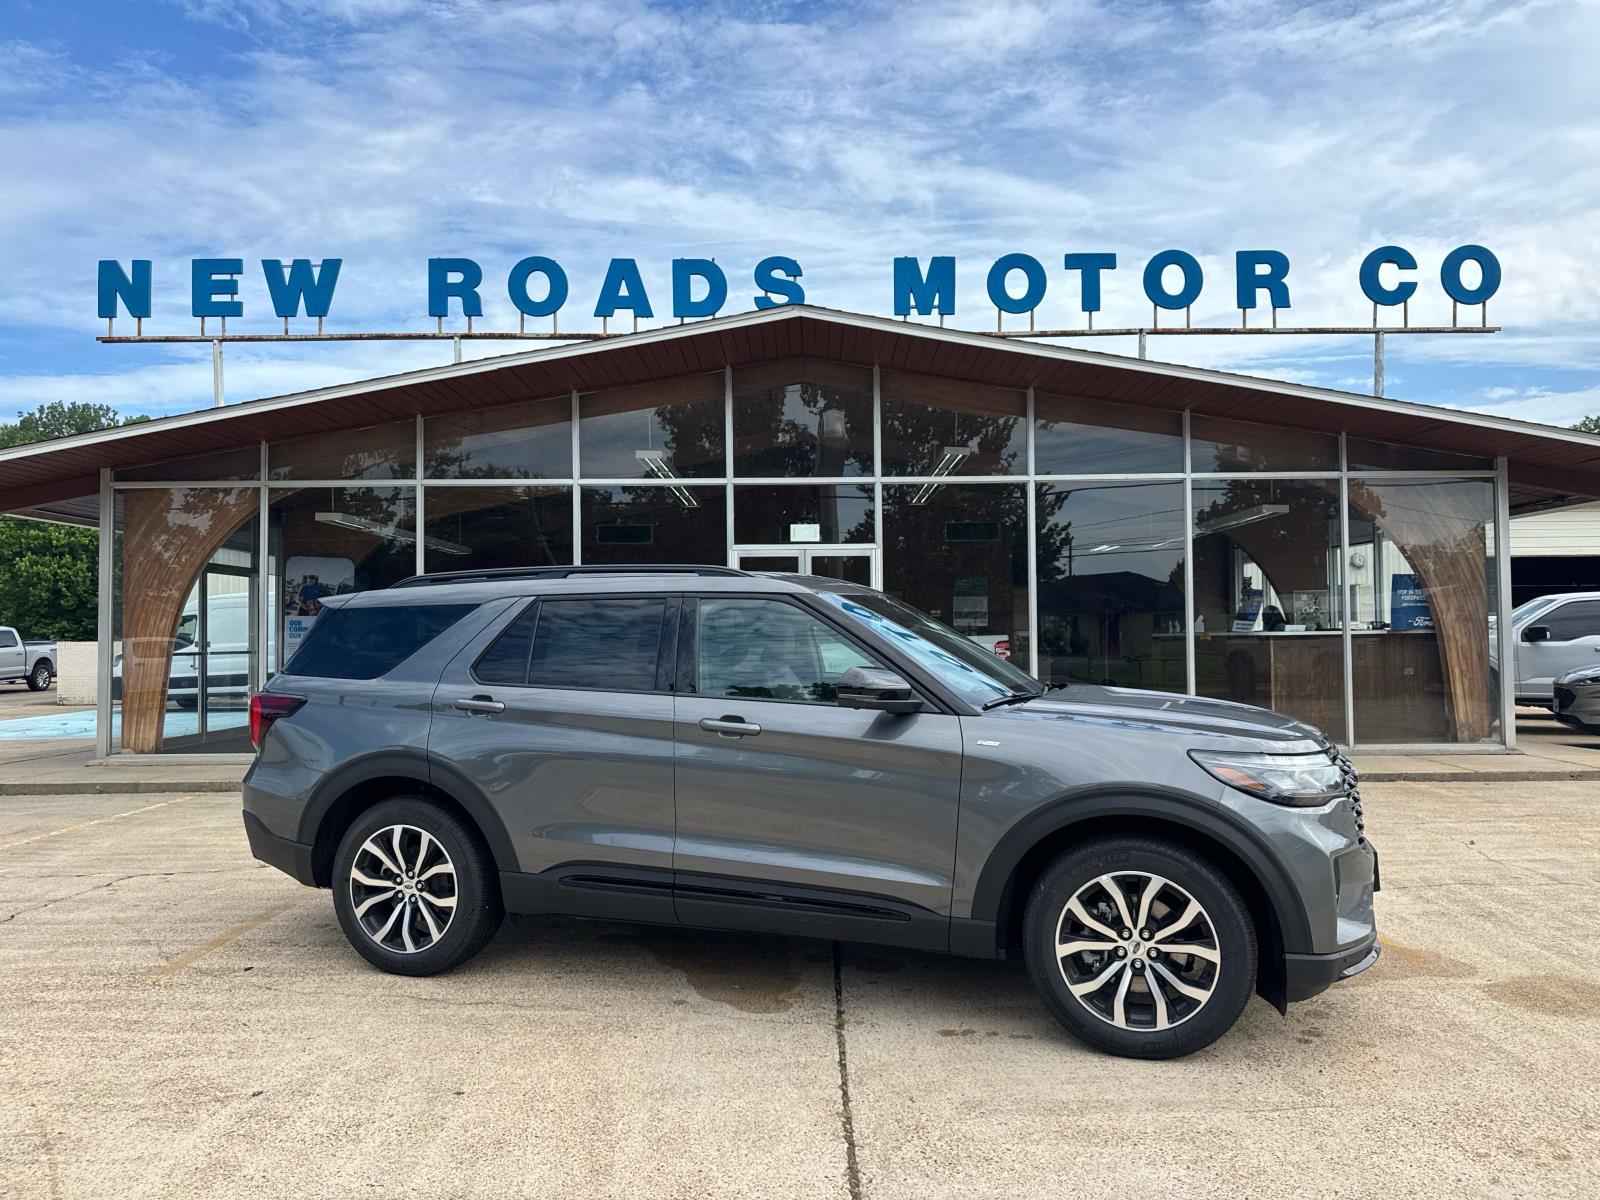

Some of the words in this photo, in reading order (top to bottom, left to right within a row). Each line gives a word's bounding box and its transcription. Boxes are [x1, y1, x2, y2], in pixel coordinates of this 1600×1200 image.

[98, 259, 341, 318] NEW
[429, 257, 805, 318] ROADS
[894, 250, 1290, 316] MOTOR
[1360, 245, 1500, 305] CO
